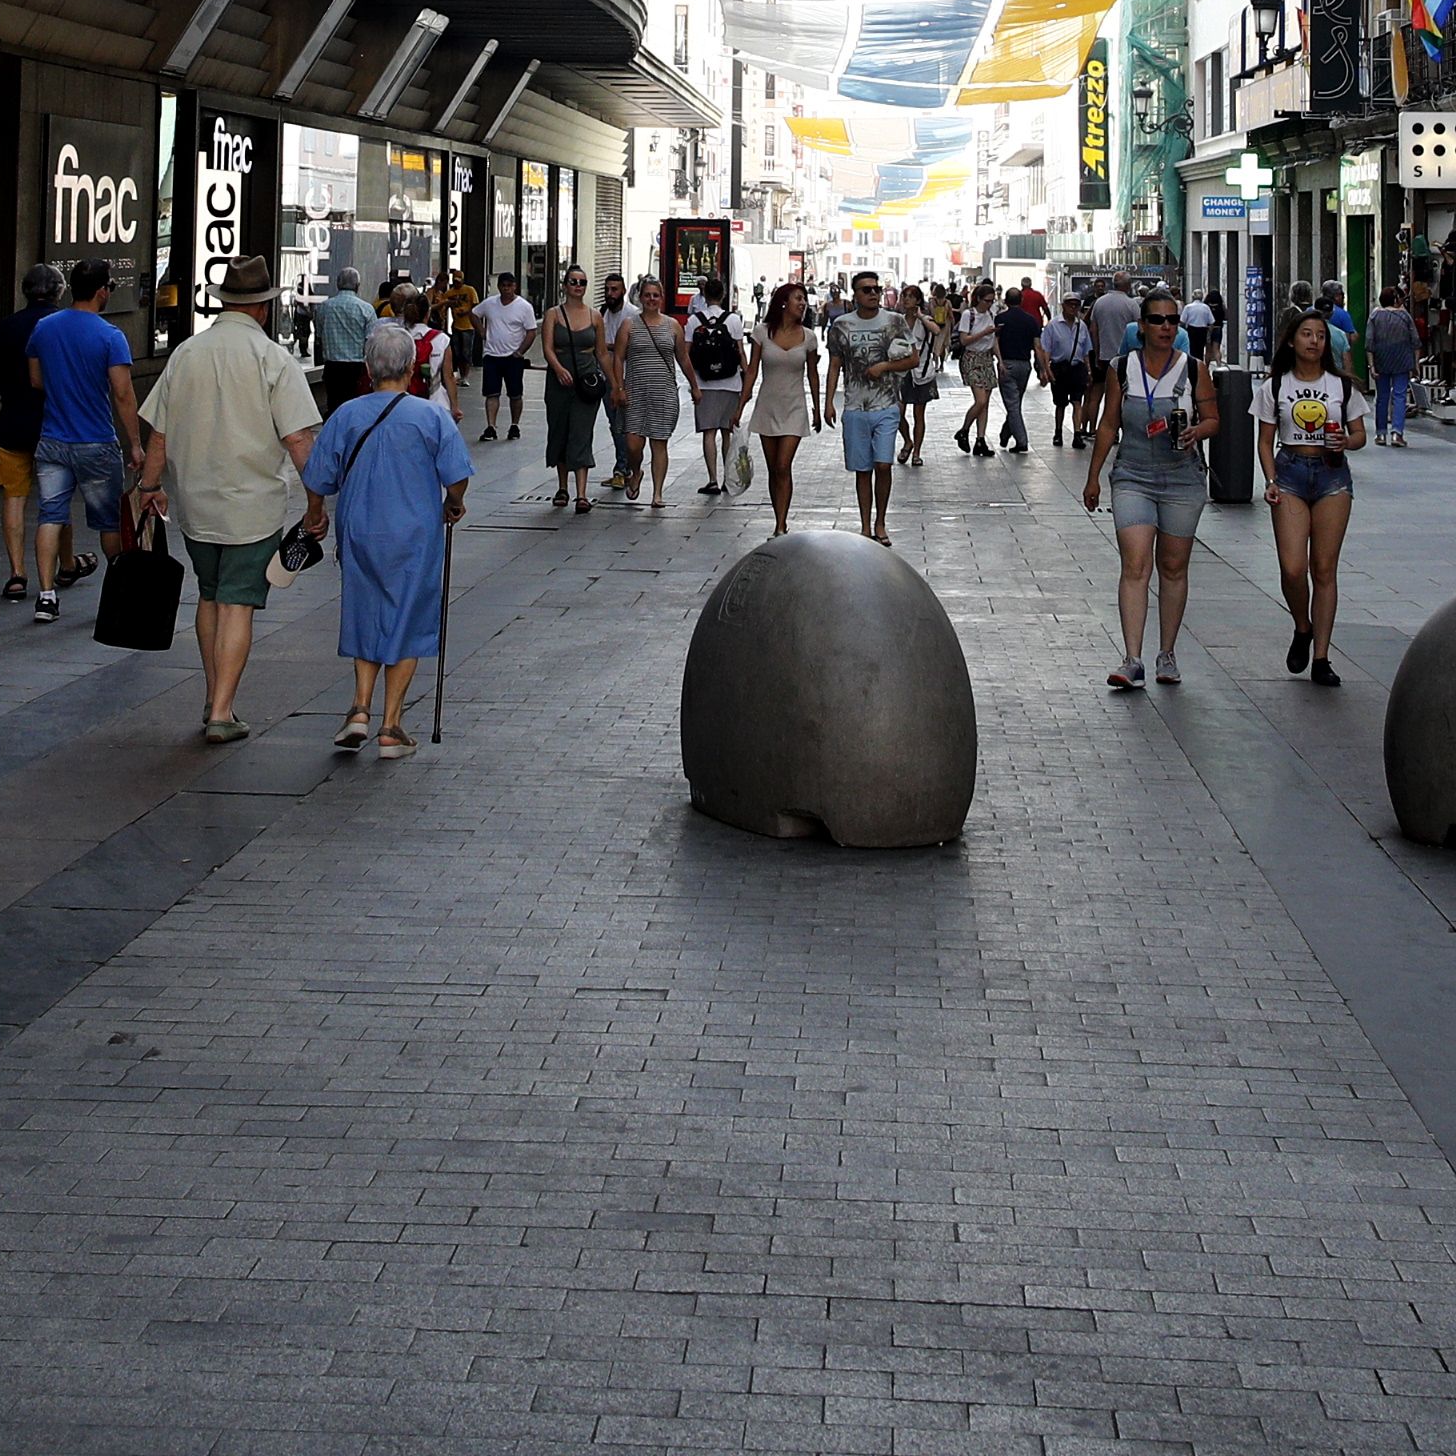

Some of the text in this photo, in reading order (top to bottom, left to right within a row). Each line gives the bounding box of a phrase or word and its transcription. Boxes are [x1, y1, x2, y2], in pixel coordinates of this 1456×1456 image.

[1082, 60, 1106, 180] Atrezzo
[214, 116, 252, 174] fnac
[54, 143, 137, 244] fnac
[454, 156, 473, 193] fnac
[495, 189, 514, 238] fnac
[1203, 199, 1243, 207] CHANGE
[1206, 208, 1241, 217] MONEY
[296, 184, 331, 306] fnac
[1287, 388, 1330, 403] I LOVE
[1294, 433, 1326, 441] TO SMIL
